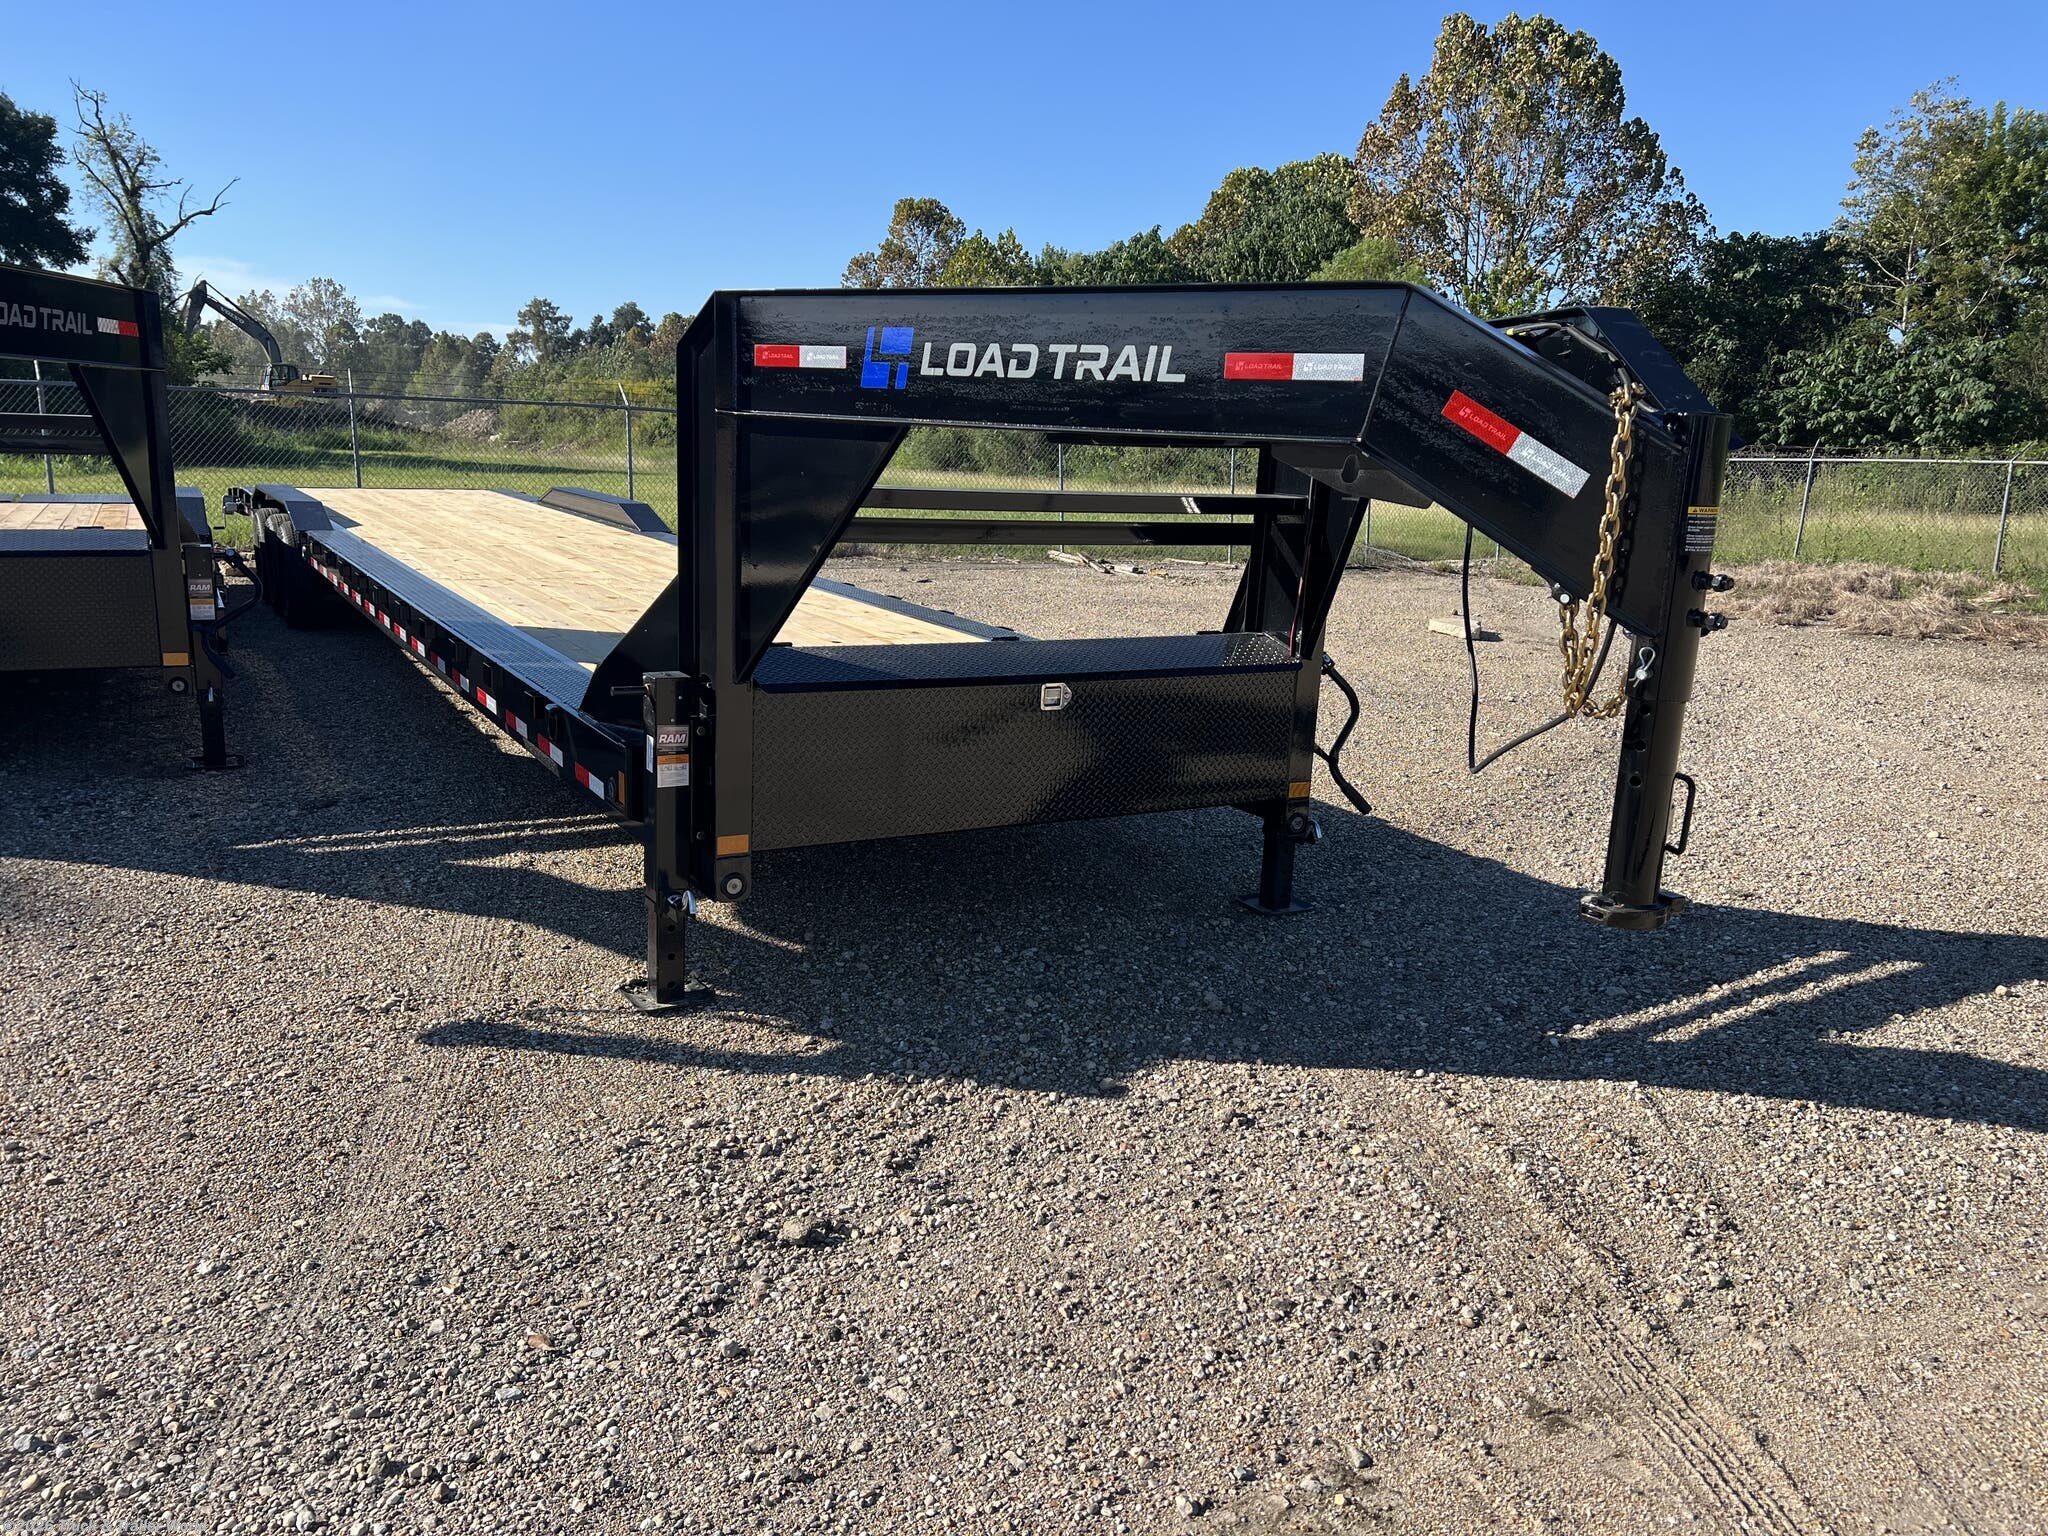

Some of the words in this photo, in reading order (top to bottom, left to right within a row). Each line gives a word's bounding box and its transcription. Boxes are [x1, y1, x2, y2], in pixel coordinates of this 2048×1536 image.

[40, 306, 93, 335] TRAIL
[920, 342, 1038, 379] LOAD
[1048, 345, 1187, 383] TRAIL
[1469, 413, 1488, 428] LOAD
[1487, 425, 1507, 441] TRAIL
[659, 733, 687, 744] RAM
